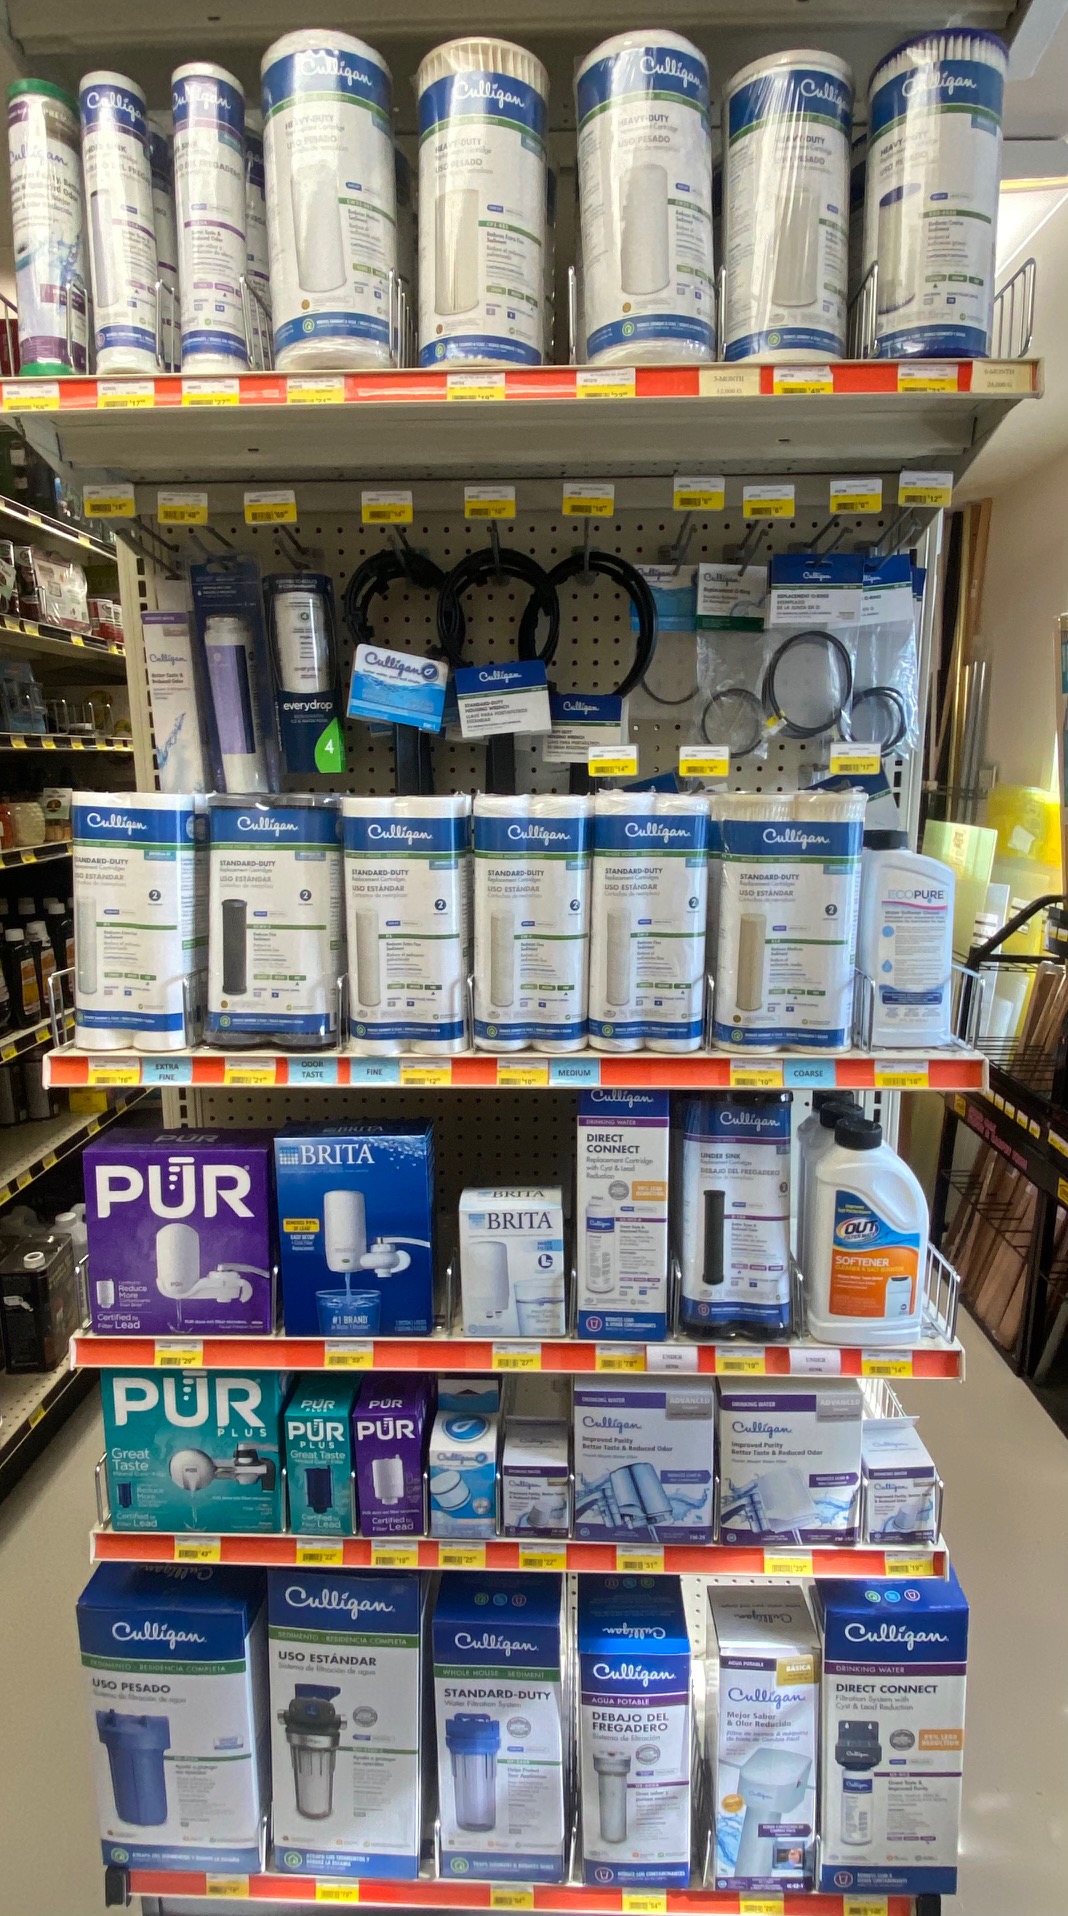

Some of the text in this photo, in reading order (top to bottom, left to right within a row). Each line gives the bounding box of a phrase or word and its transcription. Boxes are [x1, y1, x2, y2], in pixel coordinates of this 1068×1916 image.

[300, 59, 374, 86] Culligan
[901, 71, 977, 97] Culligan
[455, 79, 525, 108] Culligan
[618, 114, 669, 128] HEAVY-DUTY
[637, 135, 671, 144] PESADO
[435, 137, 482, 154] HEAVY-DUTY
[450, 158, 483, 168] PESADO
[364, 651, 423, 677] Culligan
[479, 670, 522, 683] Culligan
[283, 699, 334, 712] everydrop
[563, 701, 600, 715] Culligan
[324, 739, 335, 754] 4
[87, 812, 147, 835] Culligan
[237, 816, 299, 837] Culligan
[367, 824, 433, 845] Culligan
[507, 824, 571, 846] Culligan
[625, 822, 691, 844] Culligan
[762, 828, 831, 850] Culligan
[605, 867, 663, 875] STANDARD-DUTY
[739, 873, 799, 881] STANDARD-DUTY
[604, 881, 658, 891] USO ESTÁNDAR
[756, 887, 794, 898] ESTÁNDAR
[887, 889, 945, 901] ECOPURE
[155, 1063, 179, 1071] EXTRA
[301, 1060, 324, 1068] ODOR
[158, 1073, 175, 1081] FINE
[366, 1068, 383, 1076] FINE
[558, 1069, 591, 1077] MEDIUM
[793, 1069, 824, 1078] COARSE
[590, 1088, 654, 1108] Culligan
[719, 1111, 780, 1132] Culligan
[337, 1125, 384, 1133] BRITA
[586, 1133, 624, 1143] DIRECT
[586, 1144, 640, 1154] CONNECT
[301, 1144, 375, 1166] BRITA
[492, 1190, 545, 1198] BRITA
[487, 1211, 553, 1230] BRITA
[844, 1220, 878, 1235] OUT
[835, 1256, 889, 1266] SOFTENER
[118, 1284, 148, 1293] Reduce
[97, 1313, 132, 1322] Certified
[343, 1315, 368, 1324] BRAND
[114, 1319, 141, 1330] Lead
[582, 1415, 642, 1434] Culligan
[731, 1421, 792, 1439] Culligan
[217, 1428, 267, 1438] PLUS
[299, 1441, 335, 1449] PLUS
[582, 1435, 633, 1445] Improved Purity
[731, 1441, 783, 1449] Improved Purity
[111, 1447, 150, 1460] Great
[290, 1450, 346, 1461] Great Taste
[731, 1448, 752, 1456] Better
[112, 1460, 149, 1472] Taste
[874, 1483, 909, 1493] Culligan
[133, 1519, 158, 1528] Lead
[317, 1519, 341, 1529] Lead
[372, 1516, 405, 1525] Certified
[389, 1522, 414, 1531] Lead
[285, 1585, 395, 1620] Culligan
[111, 1621, 207, 1650] Culligan
[602, 1622, 666, 1640] Culligan
[844, 1622, 949, 1651] Culligan
[277, 1630, 407, 1645] SEDIMENTO RESIDENCIA COMPLETA
[454, 1632, 539, 1657] Culligan
[278, 1650, 377, 1666] USO ESTÁNDAR
[507, 1671, 545, 1679] SEDIMENT
[835, 1665, 905, 1674] DRINKING WATER
[593, 1663, 677, 1688] Culligan
[92, 1677, 171, 1694] USO PESADO
[835, 1683, 939, 1694] DIRECT CONNECT
[444, 1688, 552, 1701] STANDARD-DUTY
[727, 1687, 806, 1710] Culligan
[835, 1694, 867, 1703] Filtration
[591, 1697, 650, 1706] AGUA POTABLE
[879, 1702, 914, 1711] Reduction
[592, 1711, 669, 1723] DEBAJO DEL
[726, 1711, 777, 1720] Mejor Sabor
[592, 1722, 668, 1733] FREGADERO
[735, 1720, 753, 1728] Olor
[754, 1720, 792, 1728] Reducido
[592, 1732, 629, 1742] Sistema de
